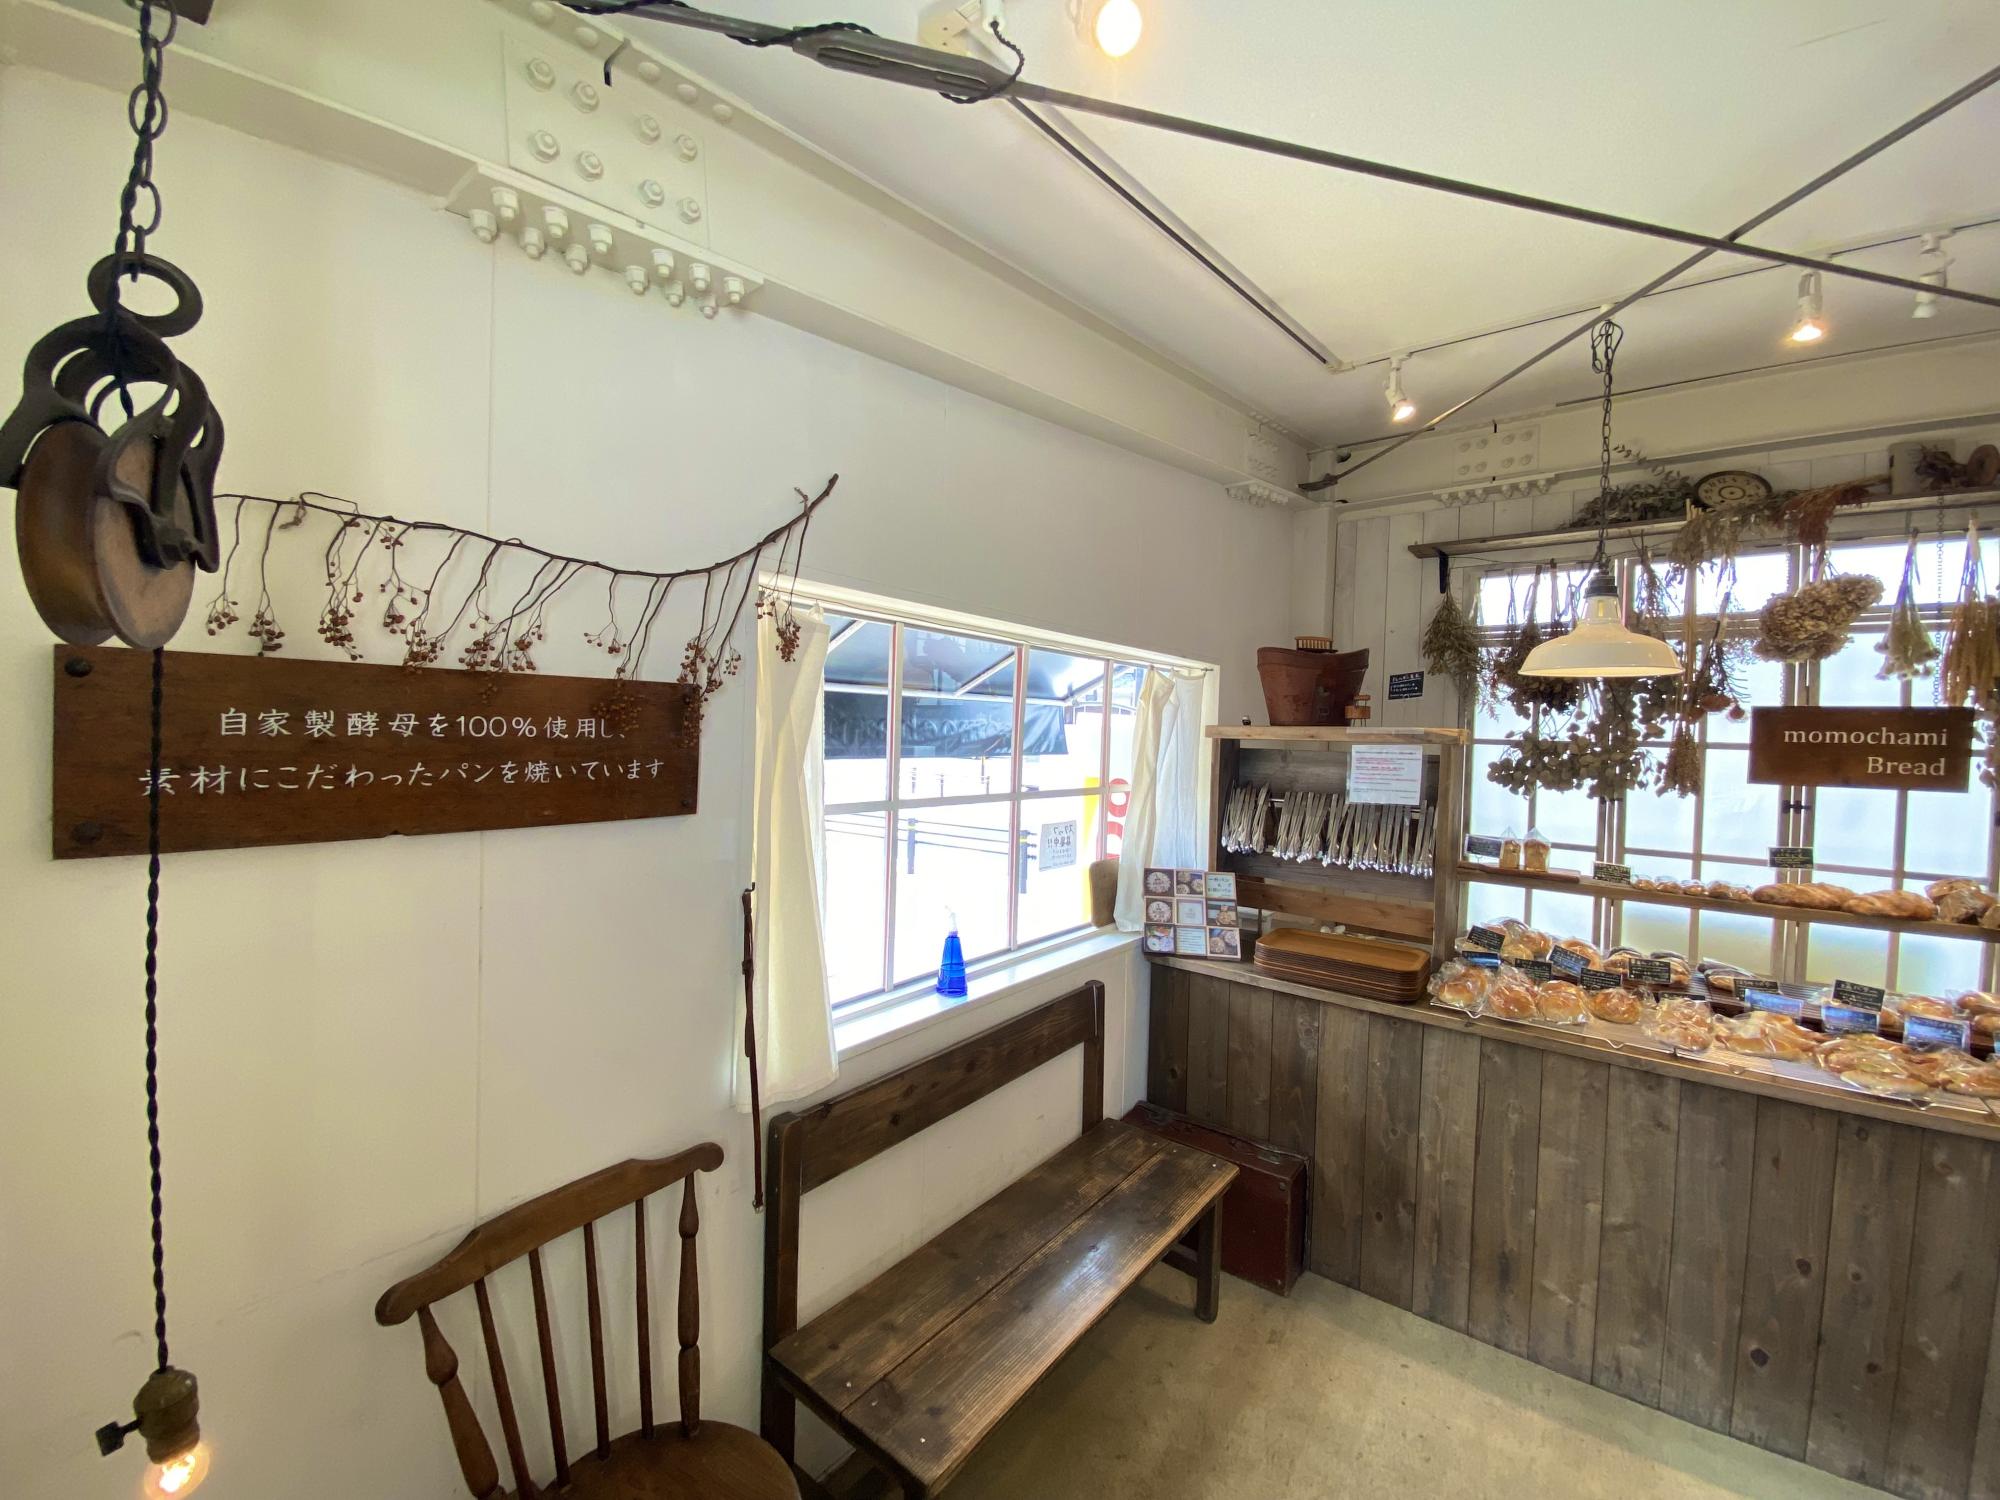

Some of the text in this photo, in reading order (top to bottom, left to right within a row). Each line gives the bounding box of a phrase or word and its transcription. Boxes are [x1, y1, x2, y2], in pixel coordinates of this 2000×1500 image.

[1784, 727, 1948, 746] momochami
[1866, 756, 1946, 776] Bread
[139, 759, 664, 796] 素材にこだわったパンを焼いています
